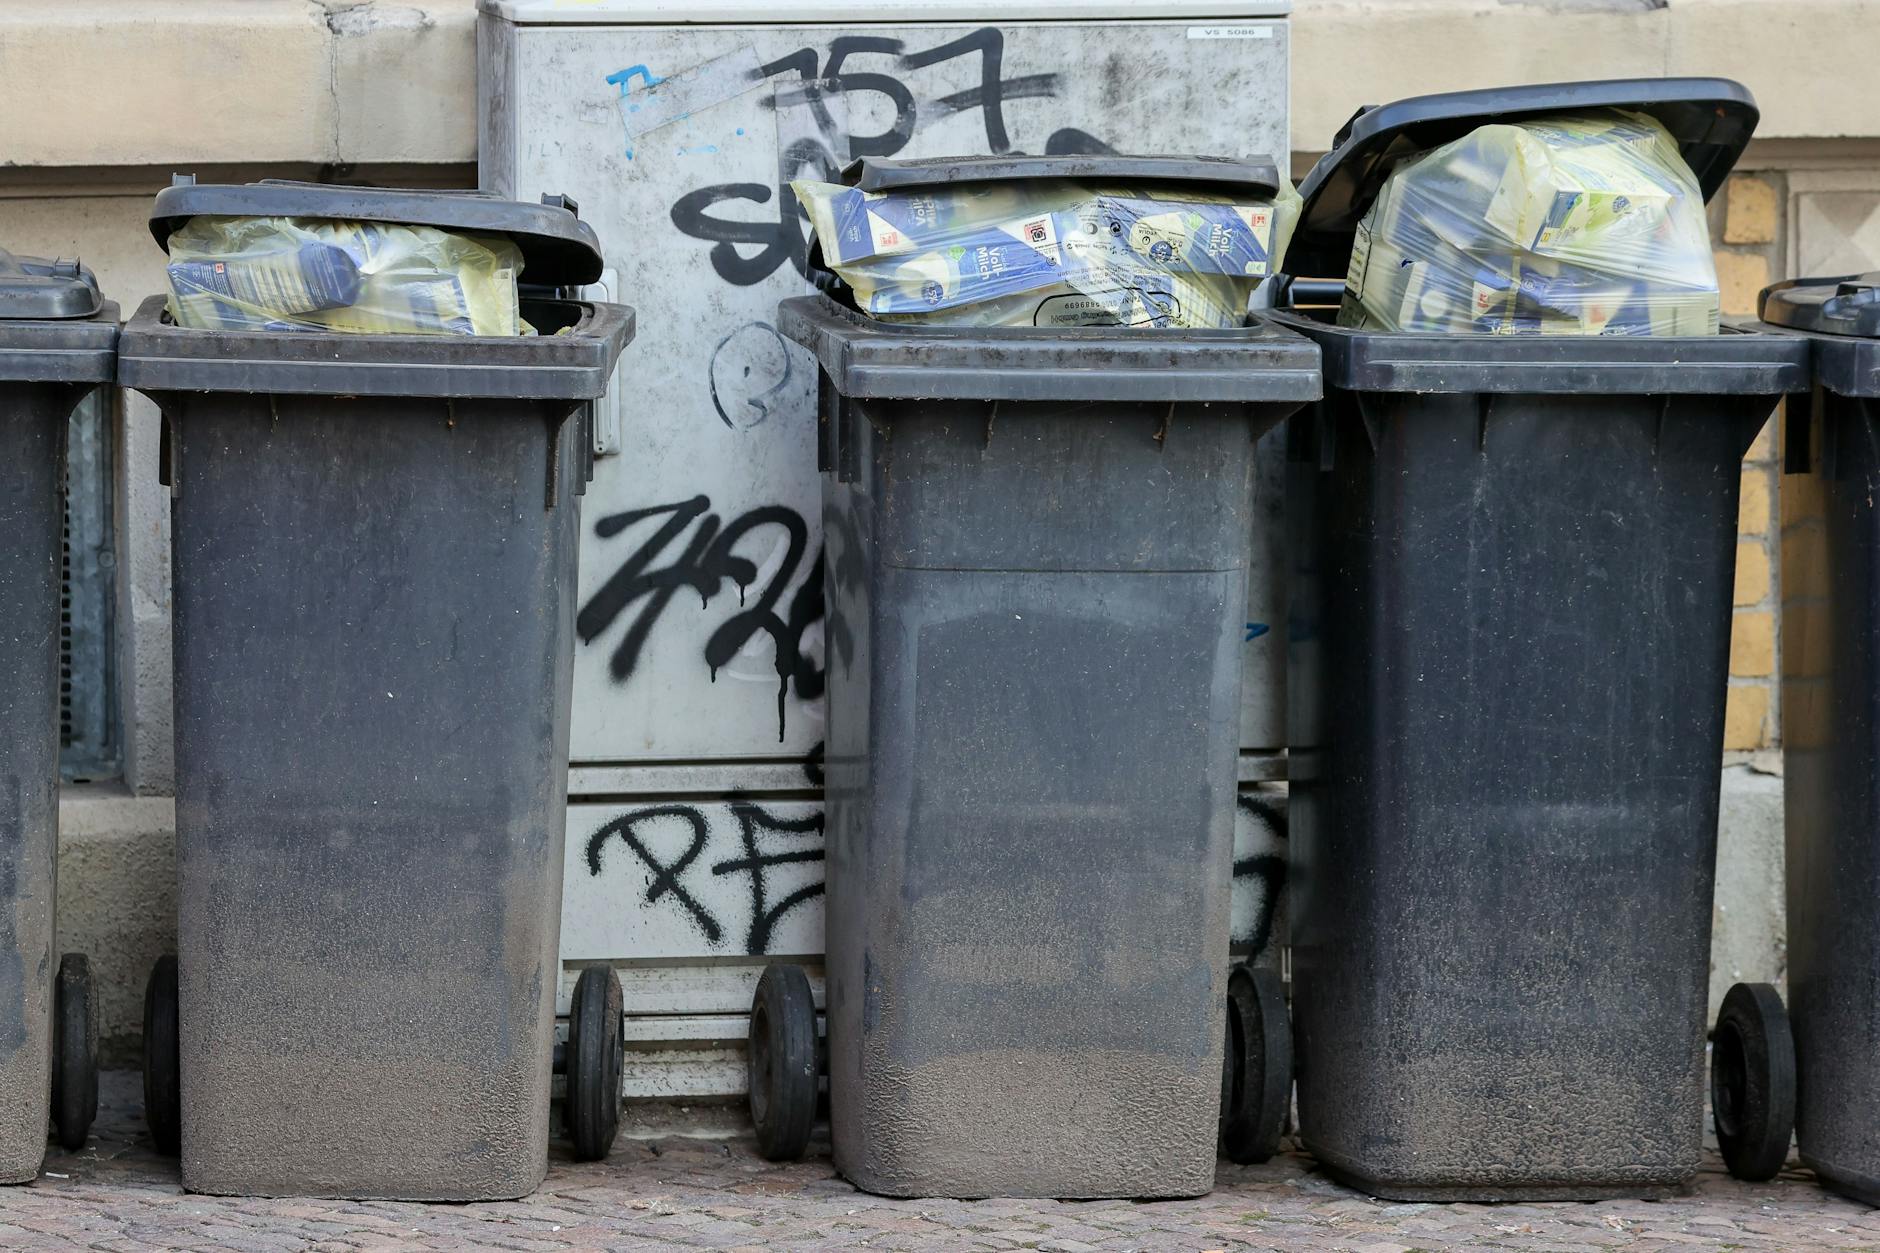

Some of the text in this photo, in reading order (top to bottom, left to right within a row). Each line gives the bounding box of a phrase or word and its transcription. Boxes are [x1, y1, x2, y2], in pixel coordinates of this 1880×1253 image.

[1207, 223, 1223, 257] Milch
[975, 246, 992, 280] Milch
[987, 246, 1005, 278] Voll-
